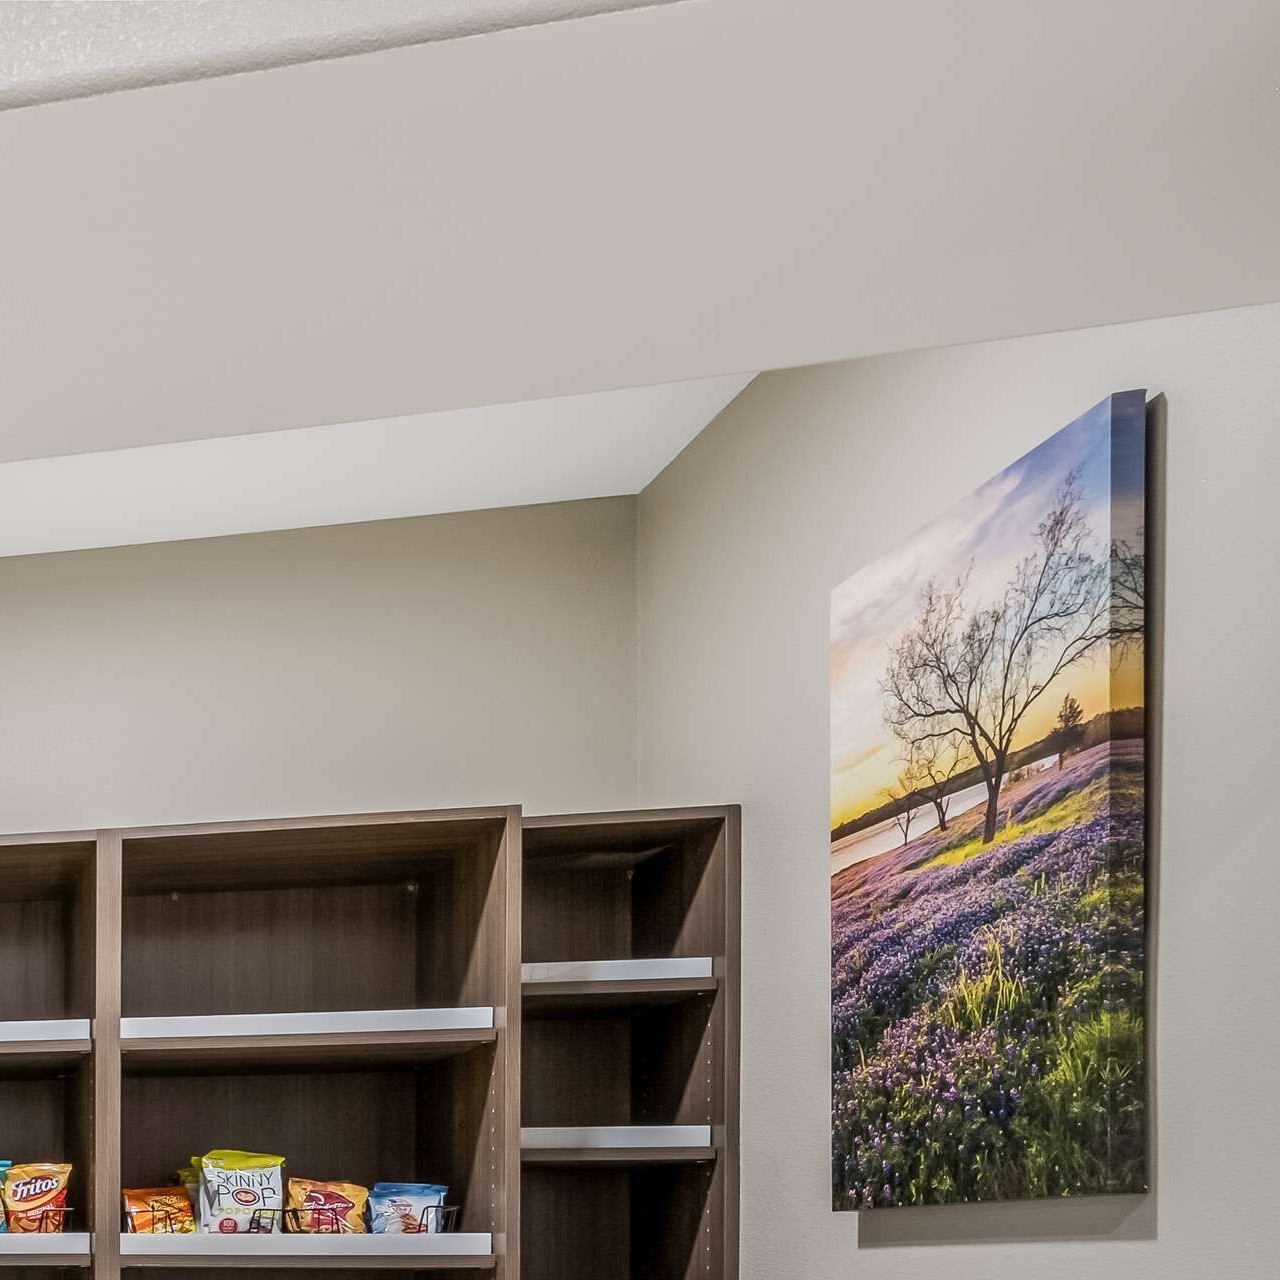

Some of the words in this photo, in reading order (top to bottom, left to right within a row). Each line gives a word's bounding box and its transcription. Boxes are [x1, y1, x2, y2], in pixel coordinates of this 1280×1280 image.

[12, 1176, 59, 1201] Fritos
[216, 1171, 273, 1188] SKINNY
[217, 1184, 277, 1207] POP
